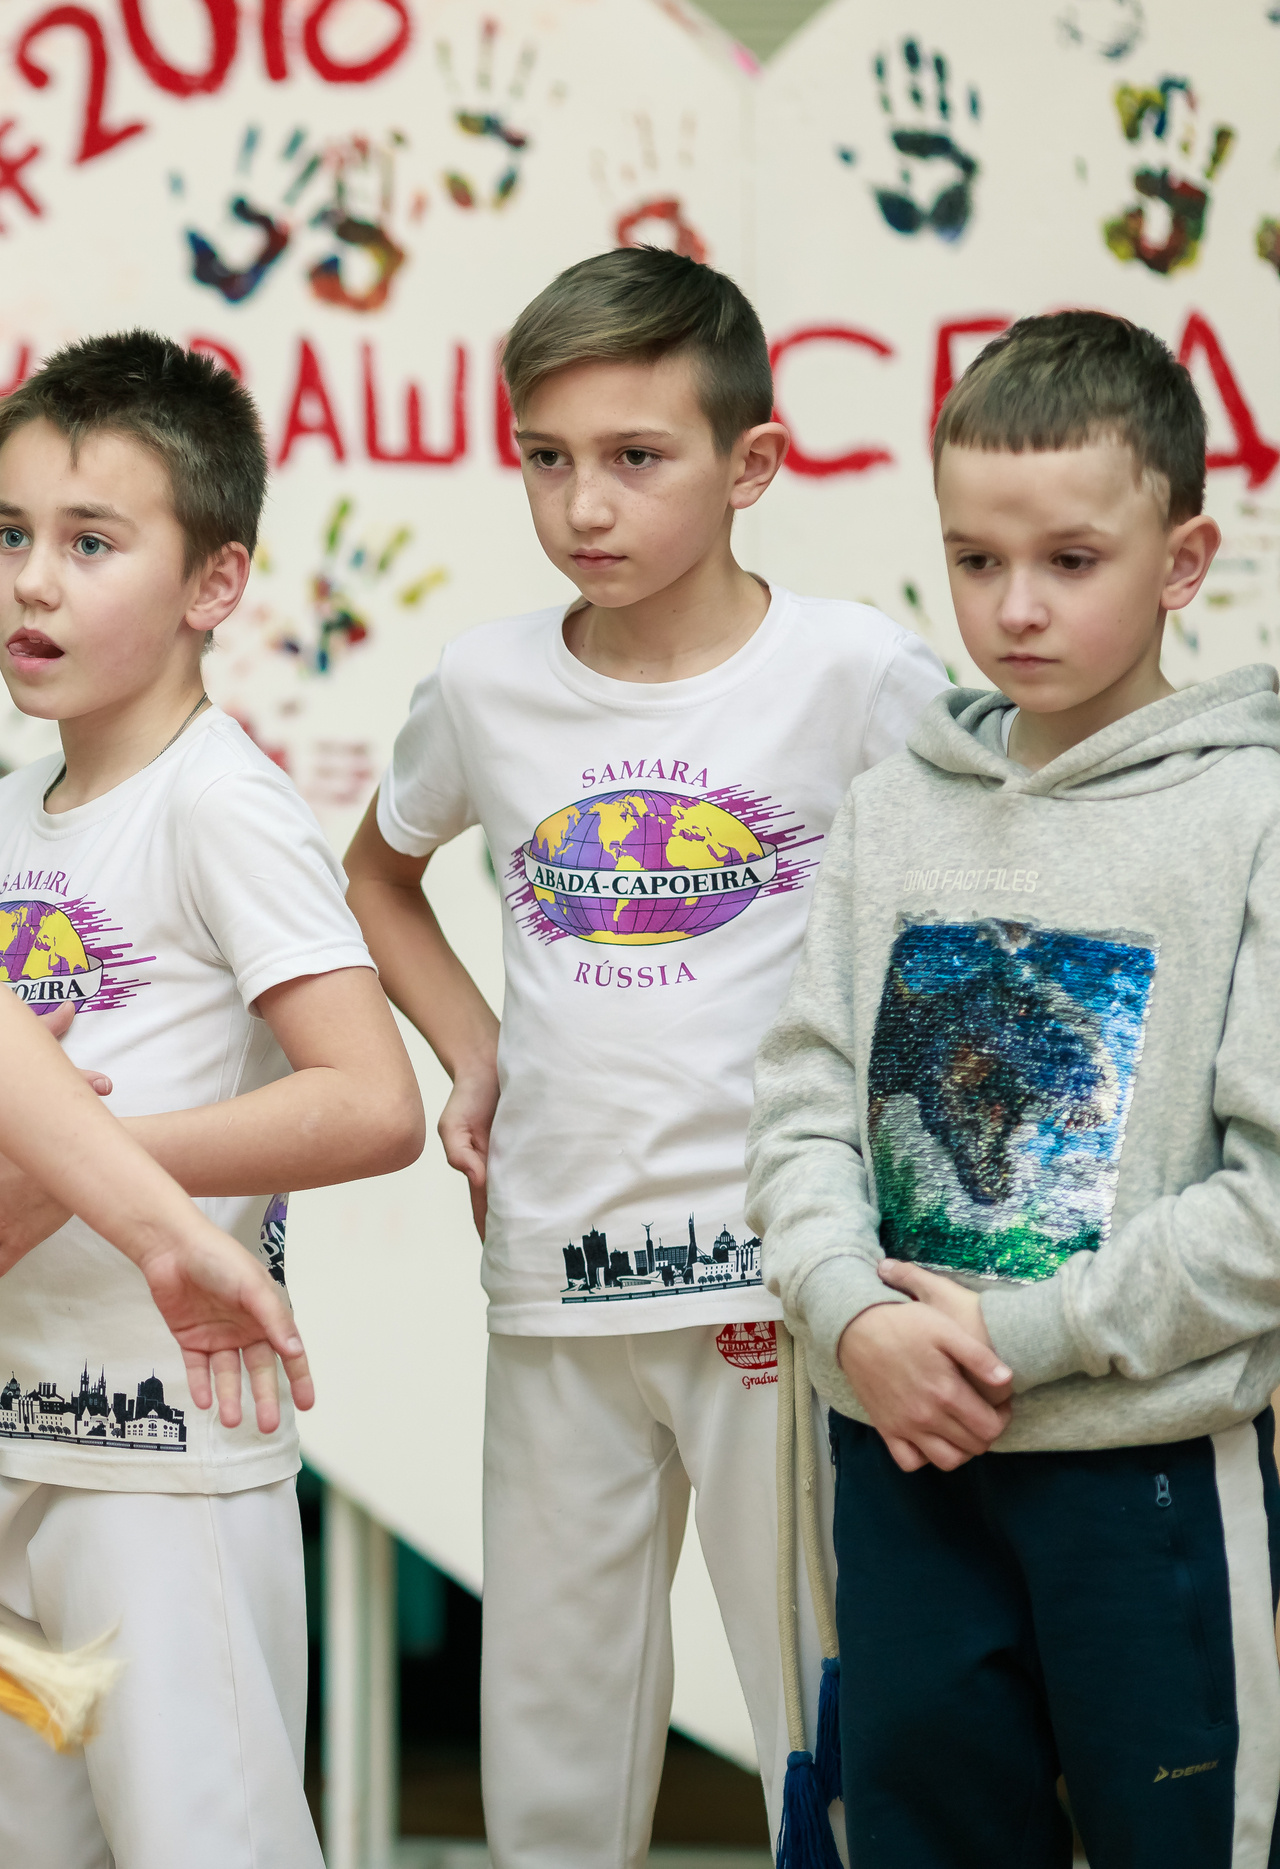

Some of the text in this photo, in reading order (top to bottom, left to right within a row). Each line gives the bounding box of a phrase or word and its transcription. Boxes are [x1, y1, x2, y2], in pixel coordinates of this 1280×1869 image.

[581, 758, 710, 788] SAMARA
[532, 865, 762, 896] ABADÁ-CAPOEIRA
[903, 867, 1039, 893] DINO FACT FILES
[573, 960, 697, 989] RÚSSIA
[1171, 1760, 1219, 1779] DEMIX
